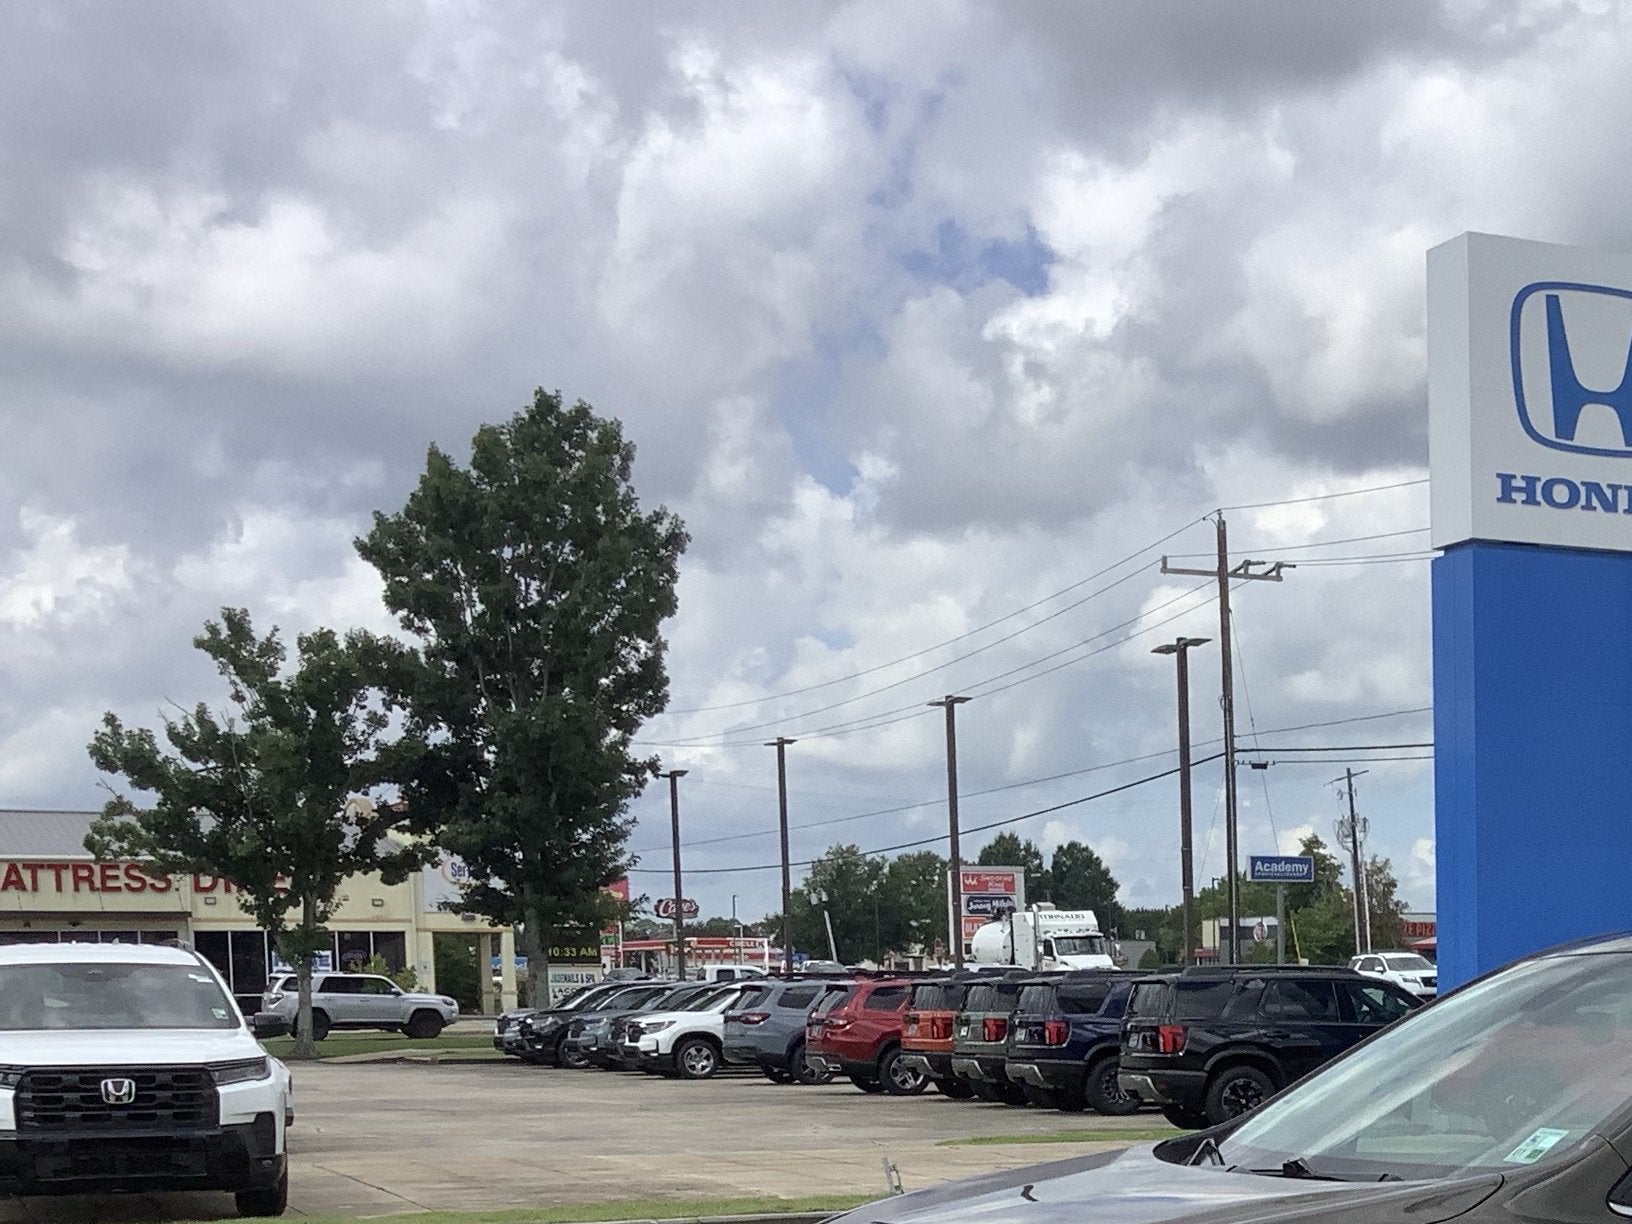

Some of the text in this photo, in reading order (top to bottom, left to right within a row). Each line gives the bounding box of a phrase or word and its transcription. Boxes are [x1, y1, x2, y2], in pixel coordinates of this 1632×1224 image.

[1255, 860, 1309, 876] Academy
[547, 947, 598, 957] 10:33 AM
